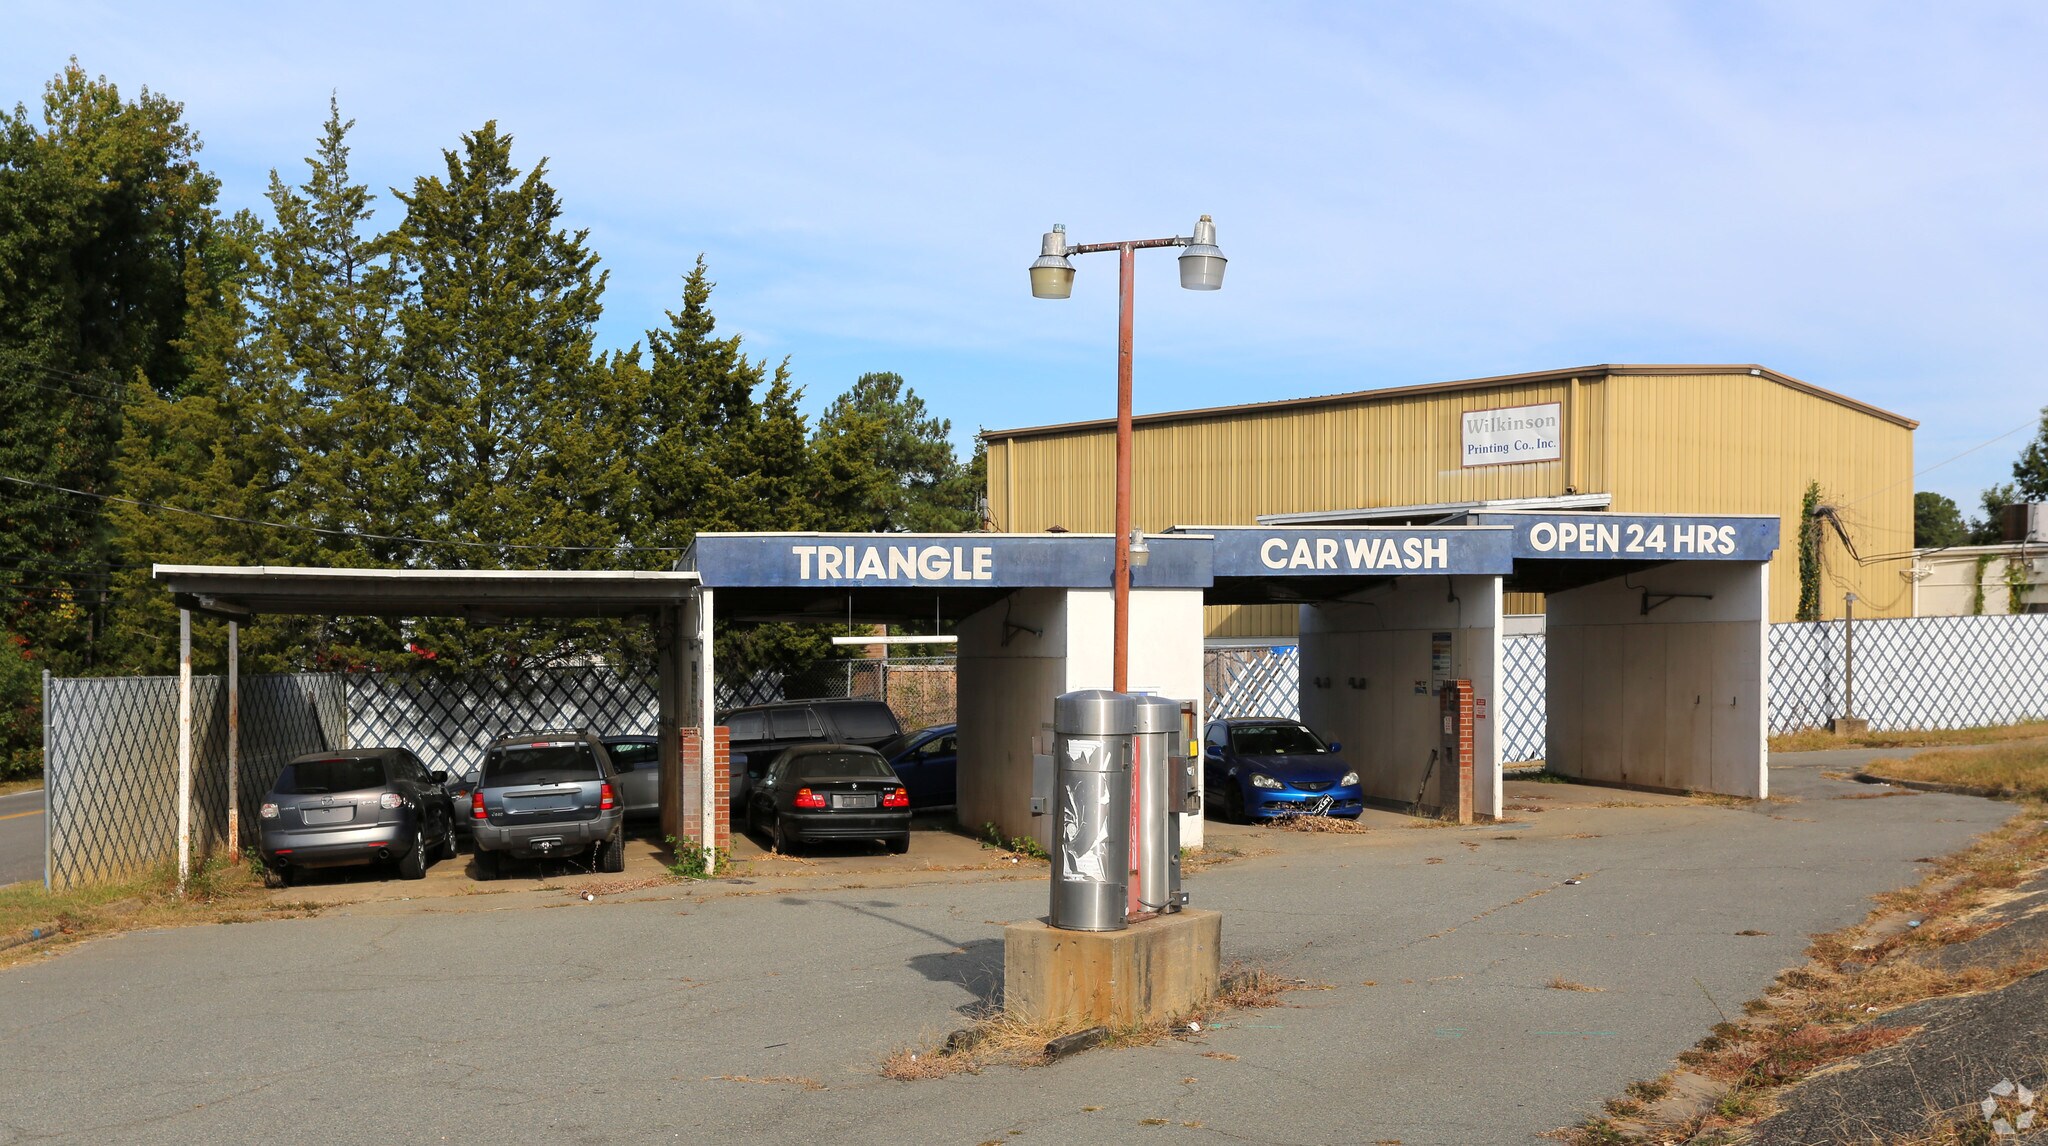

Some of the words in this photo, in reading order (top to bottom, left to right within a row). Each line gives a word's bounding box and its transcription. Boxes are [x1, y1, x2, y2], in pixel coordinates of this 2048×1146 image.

[1466, 416, 1556, 434] Wilkinson
[1467, 443, 1509, 455] Printing
[1536, 438, 1557, 449] Inc.
[1260, 537, 1339, 570] CAR
[1344, 536, 1448, 569] WASH
[1529, 522, 1620, 554] OPEN
[1625, 523, 1667, 554] 24
[1673, 524, 1737, 556] HRS
[791, 545, 993, 581] TRIANGLE
